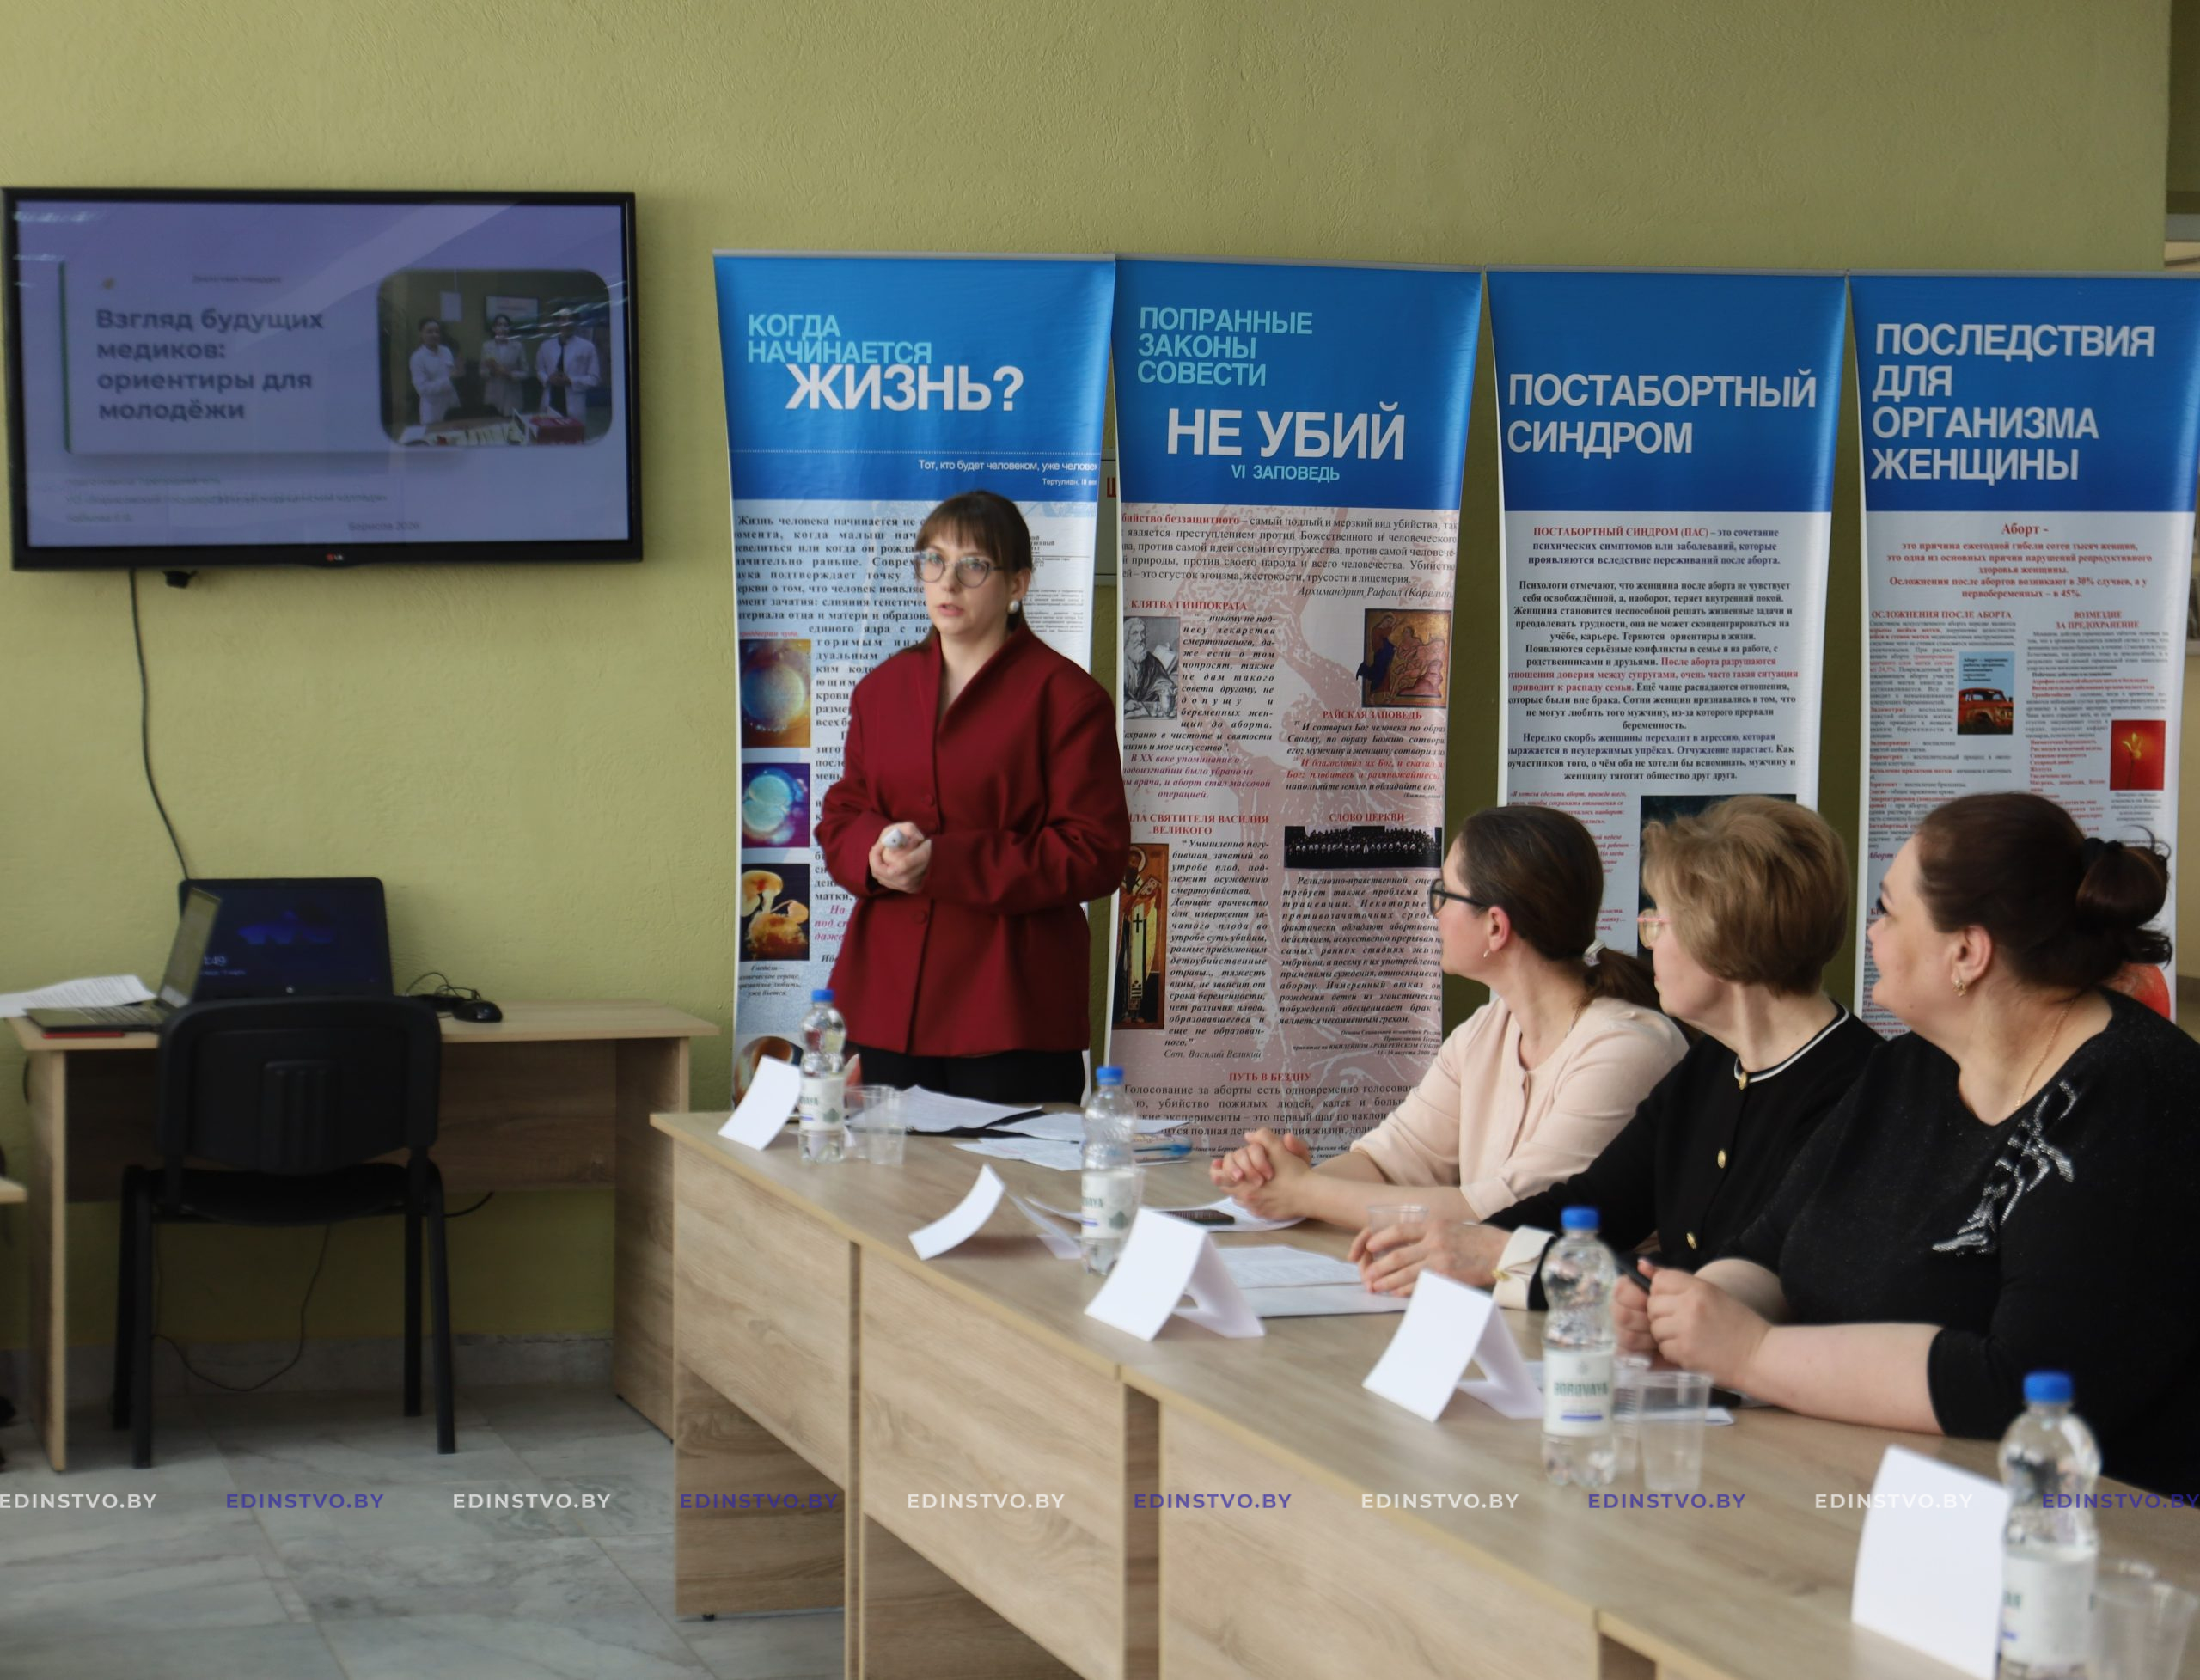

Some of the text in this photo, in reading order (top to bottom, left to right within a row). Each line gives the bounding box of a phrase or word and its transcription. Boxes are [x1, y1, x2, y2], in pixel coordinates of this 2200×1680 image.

[97, 308, 323, 334] Взгляд будущих
[1140, 307, 1312, 334] ПОПРАННЫЕ
[749, 315, 840, 342] КОГДА
[1138, 333, 1256, 359] ЗАКОНЫ
[1875, 323, 2155, 362] ПОСЛЕДСТВИЯ
[96, 342, 225, 364] медиков:
[749, 341, 932, 364] НАЧИНАЕТСЯ
[1138, 361, 1266, 386] СОВЕСТИ
[97, 370, 312, 396] ориентиры для
[785, 364, 1024, 412] ЖИЗНЬ?
[1509, 369, 1816, 408] ПОСТАБОРТНЫЙ
[1873, 365, 1952, 402] ДЛЯ
[99, 400, 246, 423] молодёжи
[1873, 406, 2099, 439] ОРГАНИЗМА
[1167, 401, 1405, 460] НЕ УБИЙ
[1507, 420, 1692, 459] СИНДРОМ
[919, 461, 938, 473] Тот,
[939, 461, 956, 471] кто
[956, 460, 985, 473] будет
[986, 461, 1040, 472] человеком,
[1042, 462, 1060, 473] уже
[1871, 449, 2079, 486] ЖЕНЩИНЫ
[1231, 465, 1340, 484] VI ЗАПОВЕДЬ
[737, 516, 915, 527] Жизнь человека начинается не
[1121, 514, 1163, 525] бийство
[1164, 513, 1240, 525] беззащитного
[1250, 516, 1282, 527] самый
[1285, 516, 1323, 528] подлый
[1333, 517, 1372, 531] мерзкий
[1374, 520, 1391, 529] вид
[1393, 518, 1441, 532] убийства,
[1533, 526, 1623, 537] ПОСТАБОРТНЫЙ
[1625, 527, 1679, 538] СИНДРОМ
[1680, 528, 1709, 539] (ПАС)
[1718, 528, 1732, 537] это
[2001, 522, 2039, 535] Аборт
[839, 531, 884, 541] малыш
[1128, 528, 1170, 538] является
[1176, 529, 1255, 543] преступлением
[1259, 531, 1295, 543] против
[1300, 530, 1373, 542] Божественного
[1678, 541, 1737, 551] заболеваний,
[1739, 543, 1777, 553] которые
[812, 559, 862, 569] раньше.
[1528, 557, 1595, 567] проявляются
[1653, 555, 1719, 567] переживаний
[1747, 554, 1780, 567] аборта.
[770, 571, 900, 583] подтверждает точку
[1158, 571, 1198, 582] сгусток
[1201, 572, 1243, 583] эгоизма,
[1244, 572, 1305, 584] жестокости,
[1306, 572, 1350, 585] трусости
[1351, 574, 1357, 583] и
[1358, 575, 1411, 586] лицемерия.
[782, 585, 805, 594] том,
[831, 585, 877, 595] человек
[1297, 586, 1365, 600] Архимандрит
[1366, 587, 1402, 600] Рафаил
[772, 598, 870, 608] зачатия: слияния
[1131, 600, 1247, 611] КЛЯТВА ГИППОКРАТА
[828, 612, 868, 623] матери
[871, 612, 879, 620] и
[1871, 611, 2012, 620] ОСЛОЖНЕНИЯ ПОСЛЕ АБОРТА
[2073, 611, 2121, 620] ВОЗМЕЗДИЕ
[808, 625, 854, 634] единого
[864, 626, 890, 637] ядра
[899, 626, 906, 634] с
[2056, 620, 2139, 630] ЗА ПРЕДОХРАНЕНИЕ
[1323, 708, 1422, 722] РАЙСКАЯ ЗАПОВЕДЬ
[1622, 720, 1687, 732] беременность.
[1563, 773, 1606, 783] женщину
[1646, 772, 1690, 781] общество
[1691, 773, 1709, 783] друг
[1714, 773, 1737, 783] друга.
[1150, 813, 1268, 824] СВЯТИТЕЛЯ ВАСИЛИЯ
[1329, 812, 1404, 823] СЛОВО ЦЕРКВИ
[1152, 826, 1213, 835] ВЕЛИКОГО
[1189, 838, 1269, 851] Умышленно погу-
[1164, 1048, 1262, 1061] Свт. Василий Великий
[1229, 1072, 1311, 1083] ПУТЬ В БЕЗДНУ
[1124, 1083, 1193, 1095] Голосование
[1213, 1084, 1252, 1097] аборты
[1256, 1086, 1281, 1096] есть
[1285, 1084, 1360, 1097] одновременно
